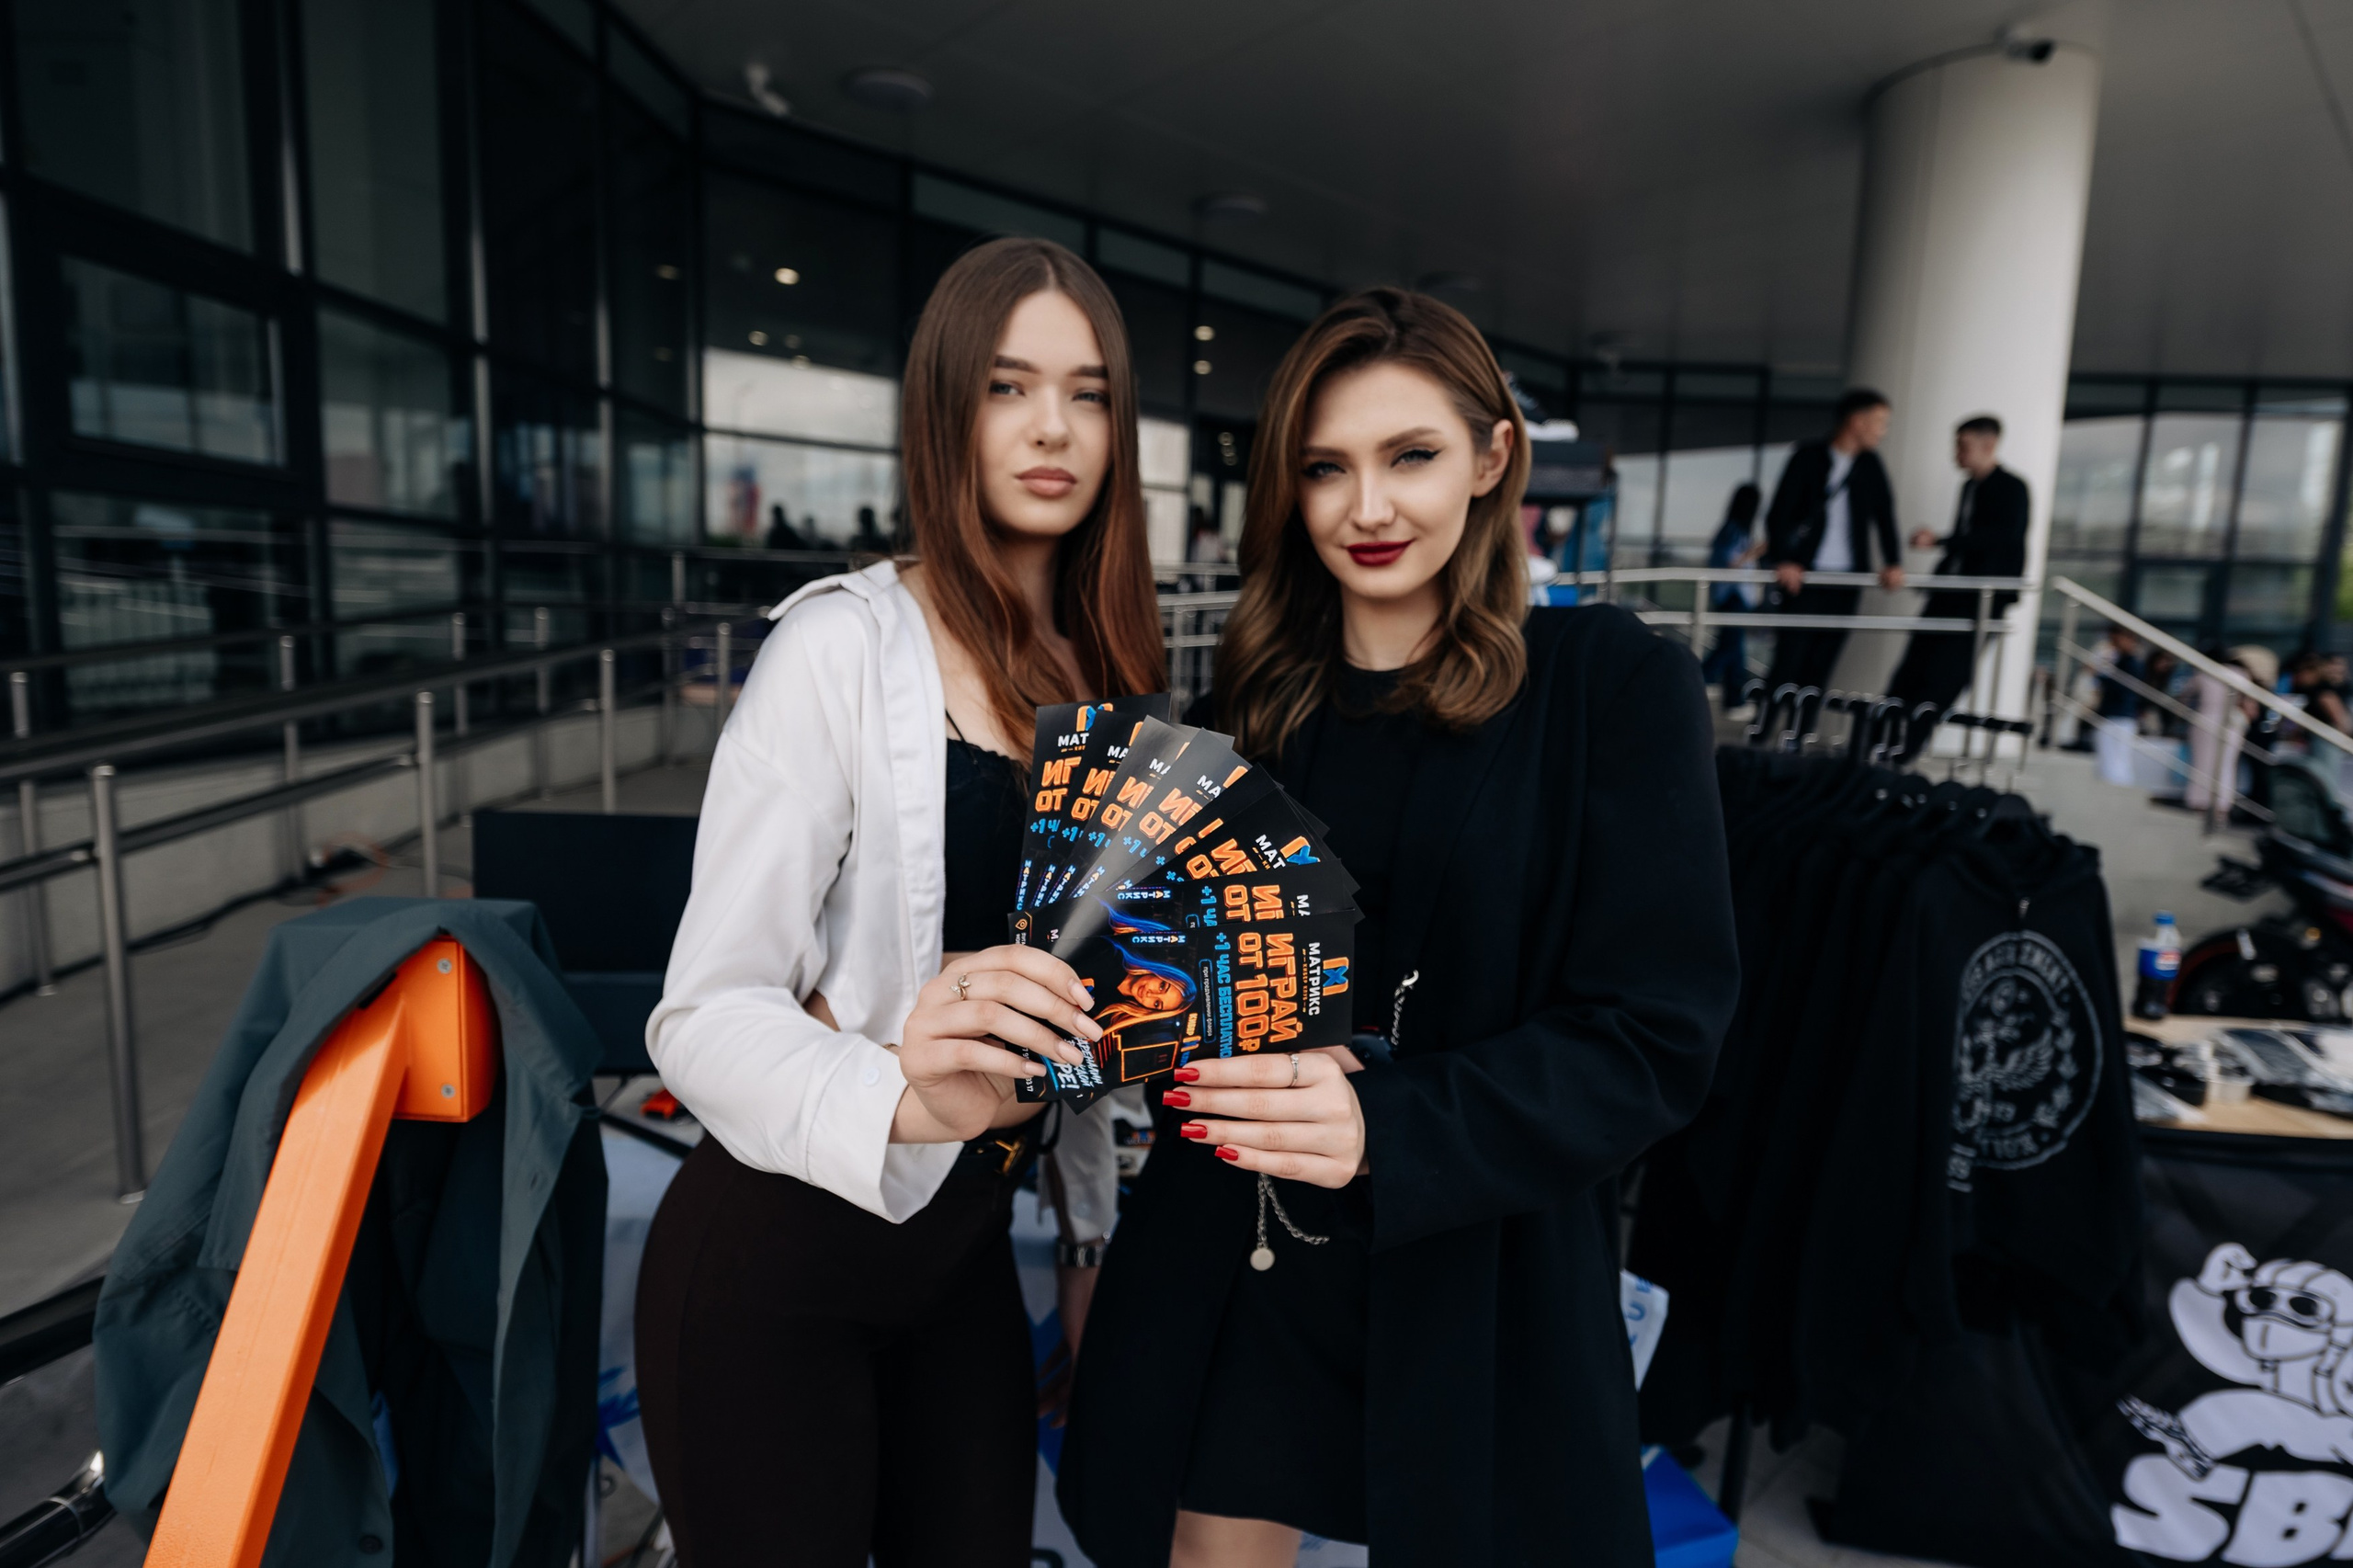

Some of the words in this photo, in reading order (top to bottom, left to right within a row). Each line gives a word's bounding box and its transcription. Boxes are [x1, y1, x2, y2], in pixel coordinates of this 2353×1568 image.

[1035, 788, 1068, 812] ОТ
[1034, 864, 1056, 907] МАТРИК
[1117, 890, 1172, 901] МАТРИКС
[1223, 884, 1251, 922] ОТ
[1203, 907, 1218, 926] ЧА
[1131, 935, 1186, 944] МАТРИКС
[1214, 932, 1231, 950] +1
[1237, 932, 1264, 970] ОТ
[1217, 954, 1231, 983] ЧАС
[1266, 932, 1303, 1043] ИГРАЙ
[1308, 942, 1321, 1016] МАТРИКС
[1218, 986, 1233, 1059] БЕСПЛАТНО
[2111, 1453, 2353, 1568] SB
